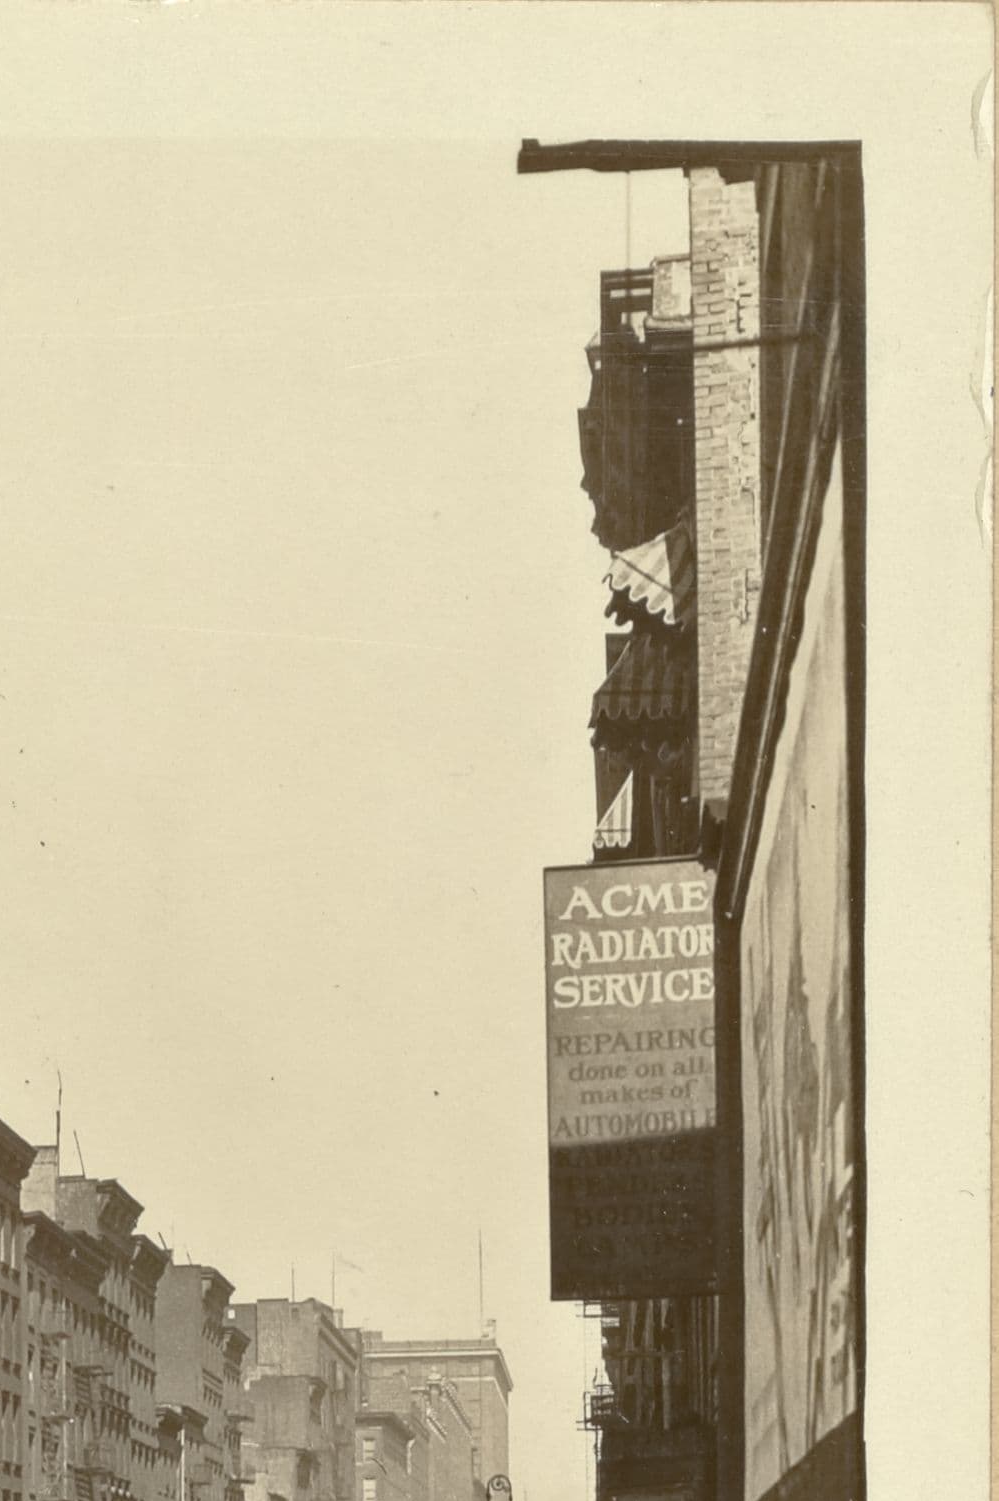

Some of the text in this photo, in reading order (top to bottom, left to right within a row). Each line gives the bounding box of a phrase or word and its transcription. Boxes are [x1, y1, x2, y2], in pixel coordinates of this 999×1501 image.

[558, 880, 710, 920] ACME
[551, 923, 715, 969] RADIATOR
[553, 967, 715, 1008] SERVICE
[554, 1026, 715, 1057] REPAIRING
[568, 1056, 706, 1082] done on all
[580, 1078, 699, 1104] makes of
